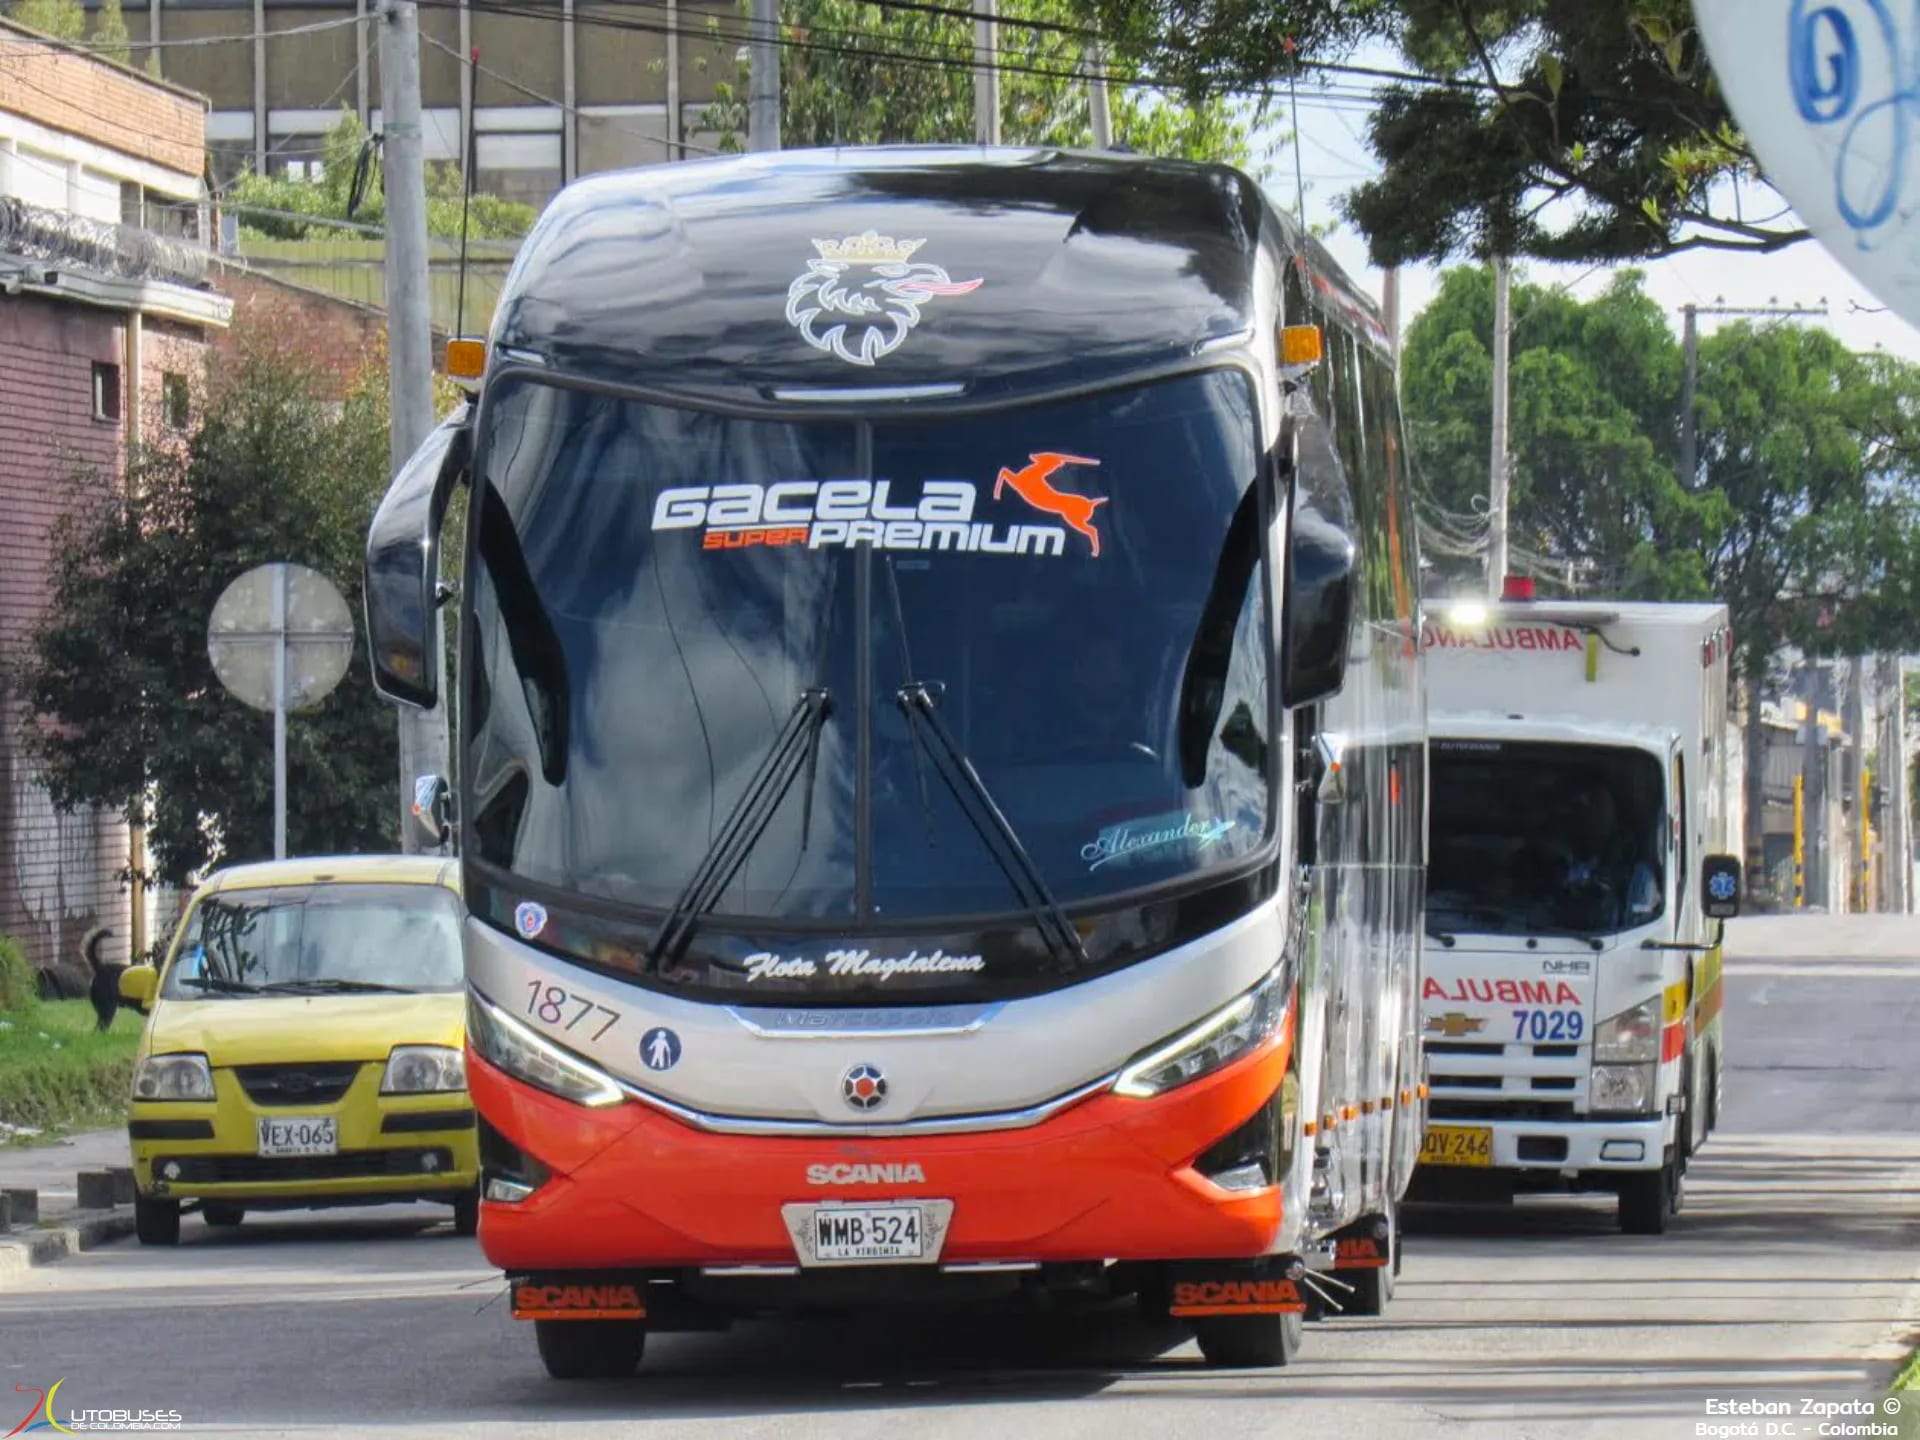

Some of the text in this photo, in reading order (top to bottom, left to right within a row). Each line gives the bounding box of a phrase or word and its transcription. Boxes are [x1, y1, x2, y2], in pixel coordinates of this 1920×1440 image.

[743, 950, 986, 982] Flota Magdalena
[528, 980, 621, 1041] 1877
[1512, 1010, 1584, 1040] 7029
[806, 1163, 926, 1184] SCANIA
[516, 1285, 640, 1308] SCANIA
[1174, 1279, 1300, 1304] SCANIA
